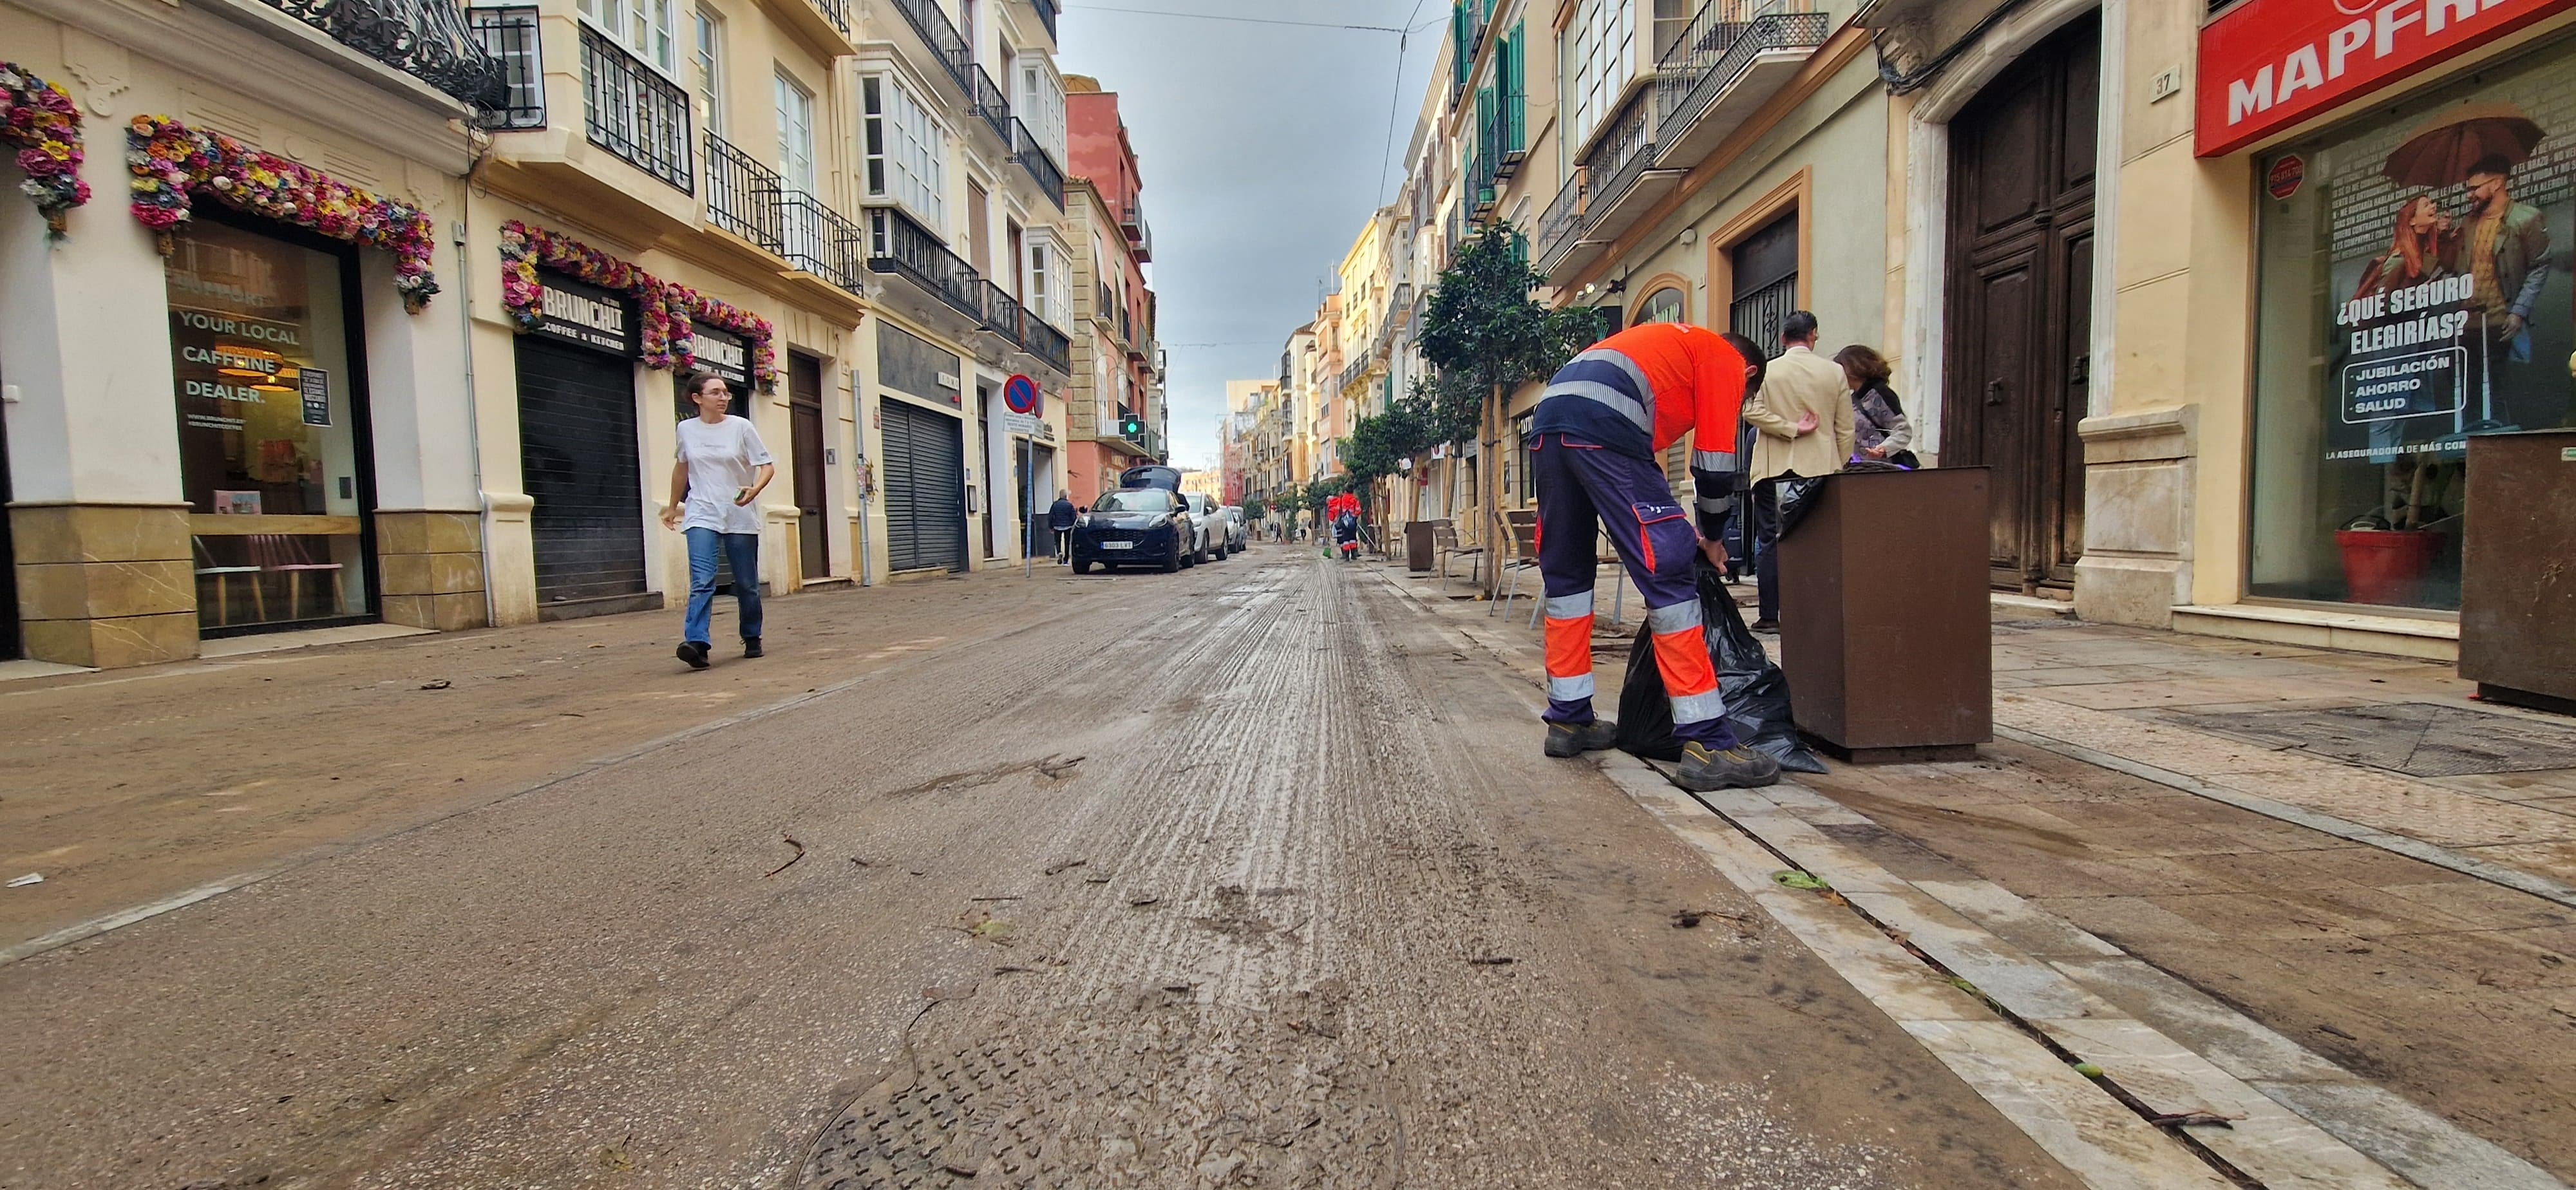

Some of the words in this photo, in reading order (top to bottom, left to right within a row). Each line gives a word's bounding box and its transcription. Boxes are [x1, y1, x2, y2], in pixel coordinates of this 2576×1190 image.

[2157, 73, 2170, 95] 37
[542, 285, 625, 336] BRUNCHIT
[2337, 288, 2385, 326] ¿QUÉ
[2390, 272, 2474, 315] SEGURO
[178, 311, 236, 335] YOUR
[242, 323, 299, 346] LOCAL
[545, 322, 578, 339] COFFEE
[591, 334, 625, 351] KITCHEN
[2351, 310, 2468, 355] ELEGIRÍAS?
[183, 346, 275, 373] CAFFEINE
[2356, 355, 2450, 381] JUBILACIÓN
[185, 381, 265, 403] DEALER.
[2355, 379, 2420, 399] AHORRO
[2355, 397, 2406, 414] SALUD
[2325, 451, 2336, 460] LA
[2337, 446, 2404, 459] ASEGURADORA
[2406, 444, 2418, 453] DE
[2420, 440, 2441, 452] MÁS
